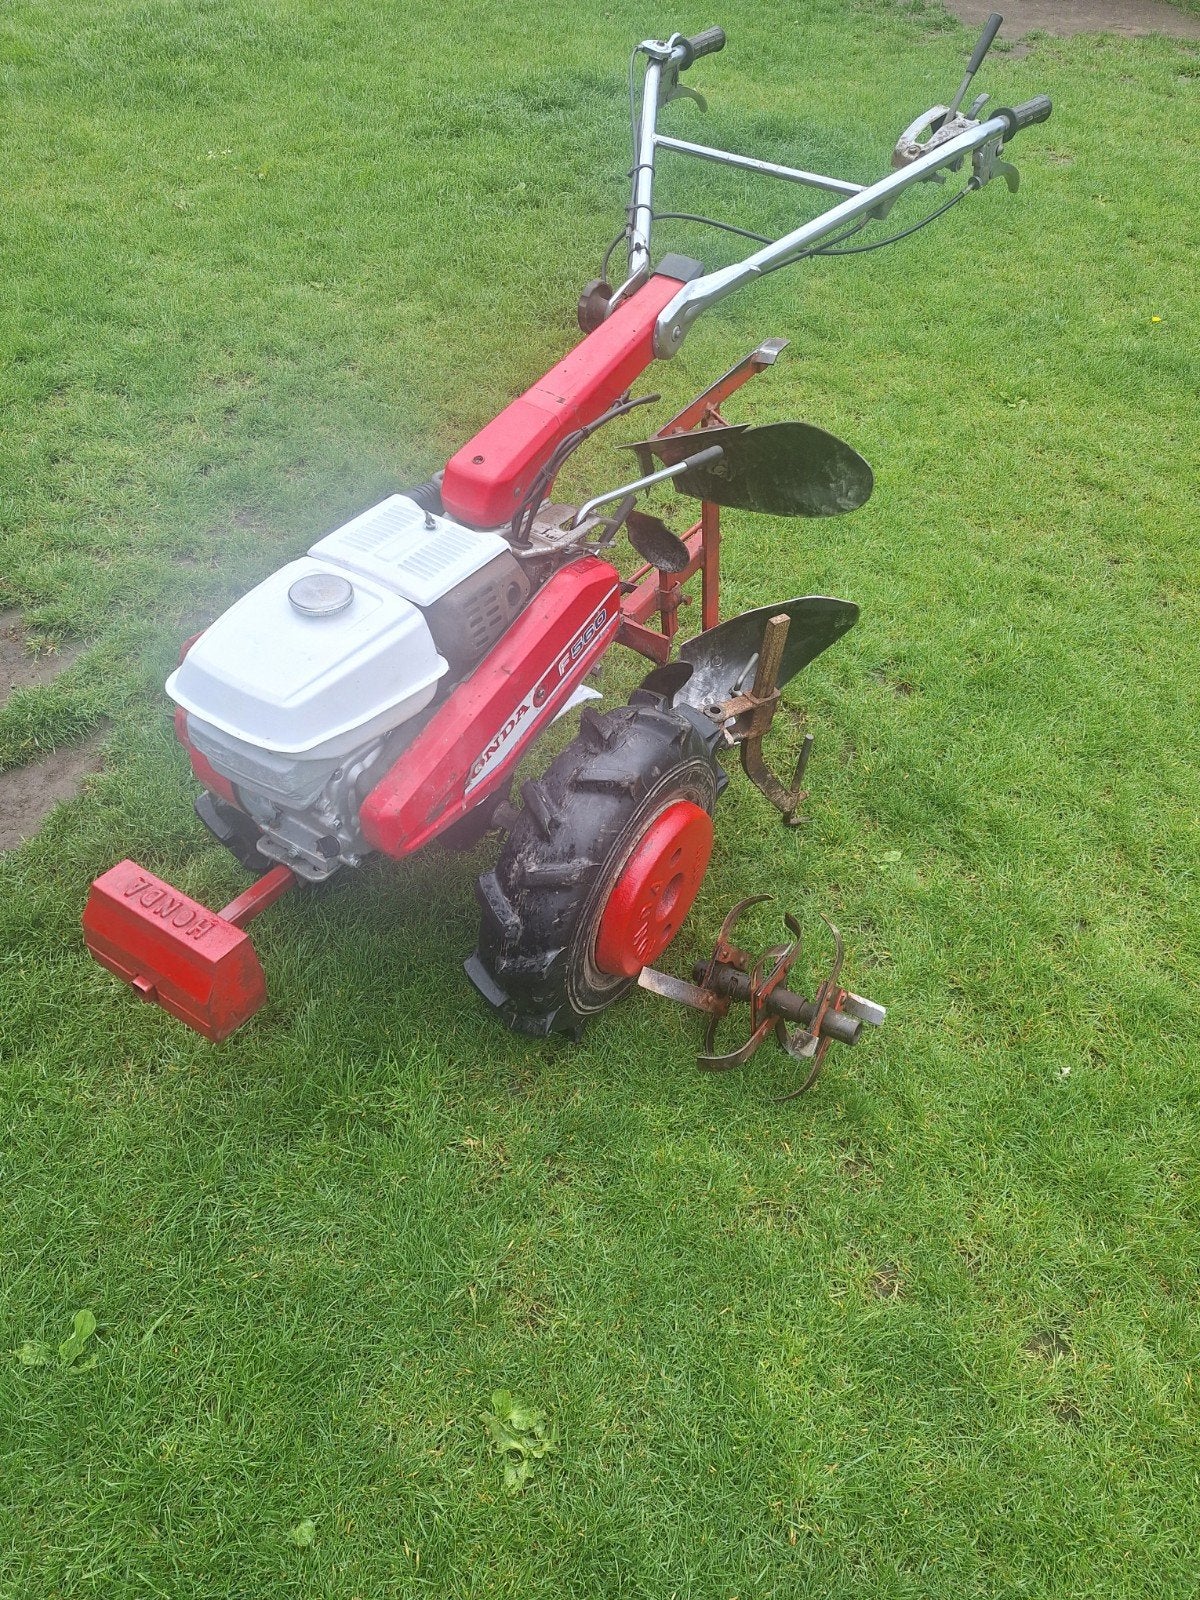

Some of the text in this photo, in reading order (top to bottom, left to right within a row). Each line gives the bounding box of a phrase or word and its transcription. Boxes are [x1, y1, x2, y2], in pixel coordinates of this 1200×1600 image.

[466, 608, 607, 786] ONDA F560
[123, 876, 218, 941] HONDA
